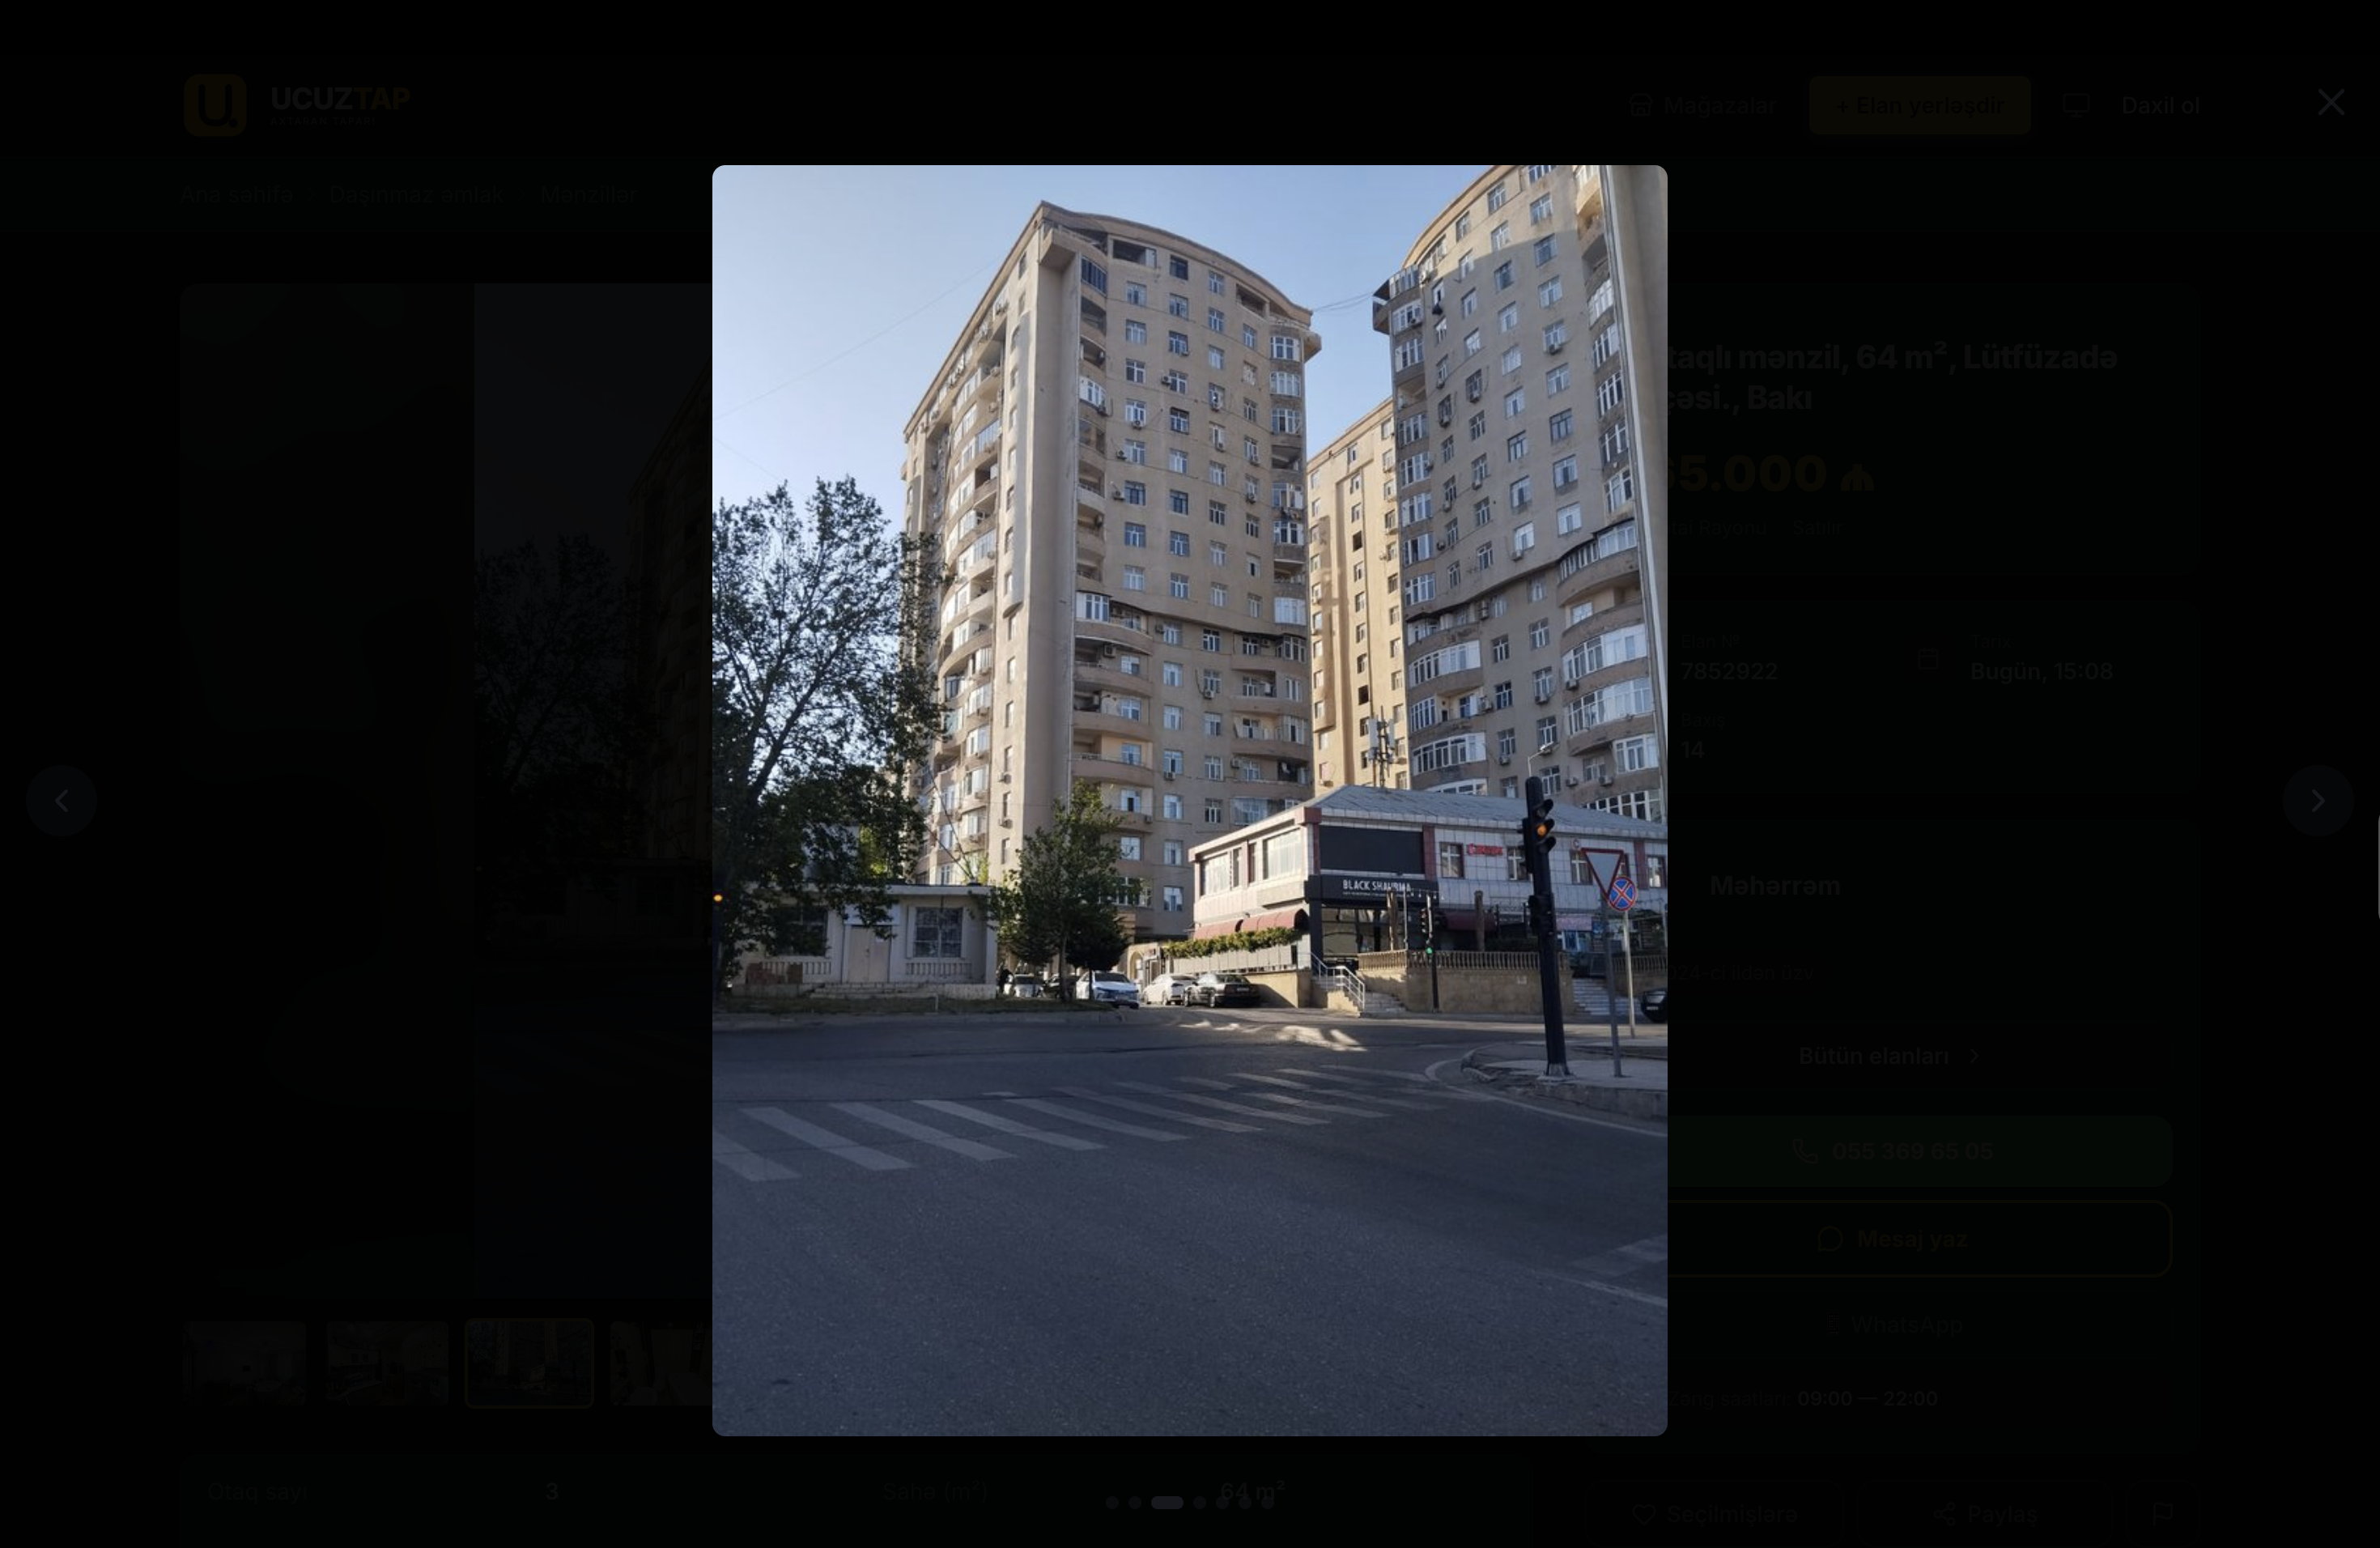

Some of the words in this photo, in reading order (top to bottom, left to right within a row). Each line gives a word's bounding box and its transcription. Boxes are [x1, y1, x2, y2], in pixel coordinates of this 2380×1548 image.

[271, 87, 411, 111] UCUZTAP
[1664, 96, 1778, 119] Mağazalar
[1857, 96, 1902, 114] Elan
[1908, 96, 2005, 119] yerləşdir
[2123, 96, 2174, 115] Daxil
[2181, 96, 2199, 115] ol
[270, 117, 327, 125] AXTARAN
[332, 117, 376, 125] TAPAR!
[180, 185, 220, 203] Ana
[228, 185, 293, 203] səhifə
[330, 185, 434, 208] Daşınmaz
[441, 185, 504, 203] əmlak
[541, 185, 638, 203] Mənzillər
[1668, 343, 1732, 375] taqlı
[1739, 342, 1849, 375] mənzil,
[1856, 343, 1898, 370] 64
[1905, 340, 1957, 375] m²,
[1964, 342, 2119, 370] Lütfüzadə
[1748, 385, 1813, 410] Bakı
[1668, 454, 1827, 492] 5.000
[1668, 519, 1693, 535] tai
[1699, 519, 1766, 539] Rayonu
[1792, 519, 1843, 535] Satılır
[1681, 634, 1715, 649] Elan
[1970, 633, 2012, 649] Tarix
[1681, 661, 1778, 680] 7852922
[1971, 661, 2047, 685] Bugün,
[2054, 661, 2114, 680] 15:08
[1681, 712, 1726, 731] Baxış
[1681, 740, 1705, 759] 14
[1343, 879, 1370, 891] BLACK
[1711, 875, 1841, 895] Məhərrəm
[1668, 964, 1726, 980] 024-ci
[1732, 964, 1775, 980] ildən
[1782, 964, 1814, 980] üzv
[1800, 1046, 1863, 1065] Bütün
[1869, 1046, 1949, 1065] elanları
[1832, 1142, 1876, 1160] 055
[1881, 1142, 1925, 1160] 369
[1931, 1142, 1959, 1160] 65
[1965, 1142, 1994, 1160] 05
[1858, 1228, 1923, 1252] Mesaj
[1929, 1233, 1968, 1252] yaz
[1851, 1316, 1963, 1338] WhatsApp
[1668, 1391, 1714, 1410] Zəng
[1720, 1391, 1791, 1406] saatları:
[1797, 1390, 1853, 1406] 09:00
[1883, 1390, 1938, 1406] 22:00
[208, 1482, 258, 1505] Otaq
[266, 1486, 307, 1505] sayı
[545, 1482, 559, 1500] 3
[883, 1482, 936, 1500] Sahə
[944, 1479, 988, 1503] (m²)
[1221, 1482, 1249, 1500] 64
[1667, 1504, 1798, 1528] Seçilmişlərə
[1968, 1504, 2038, 1528] Paylaş
